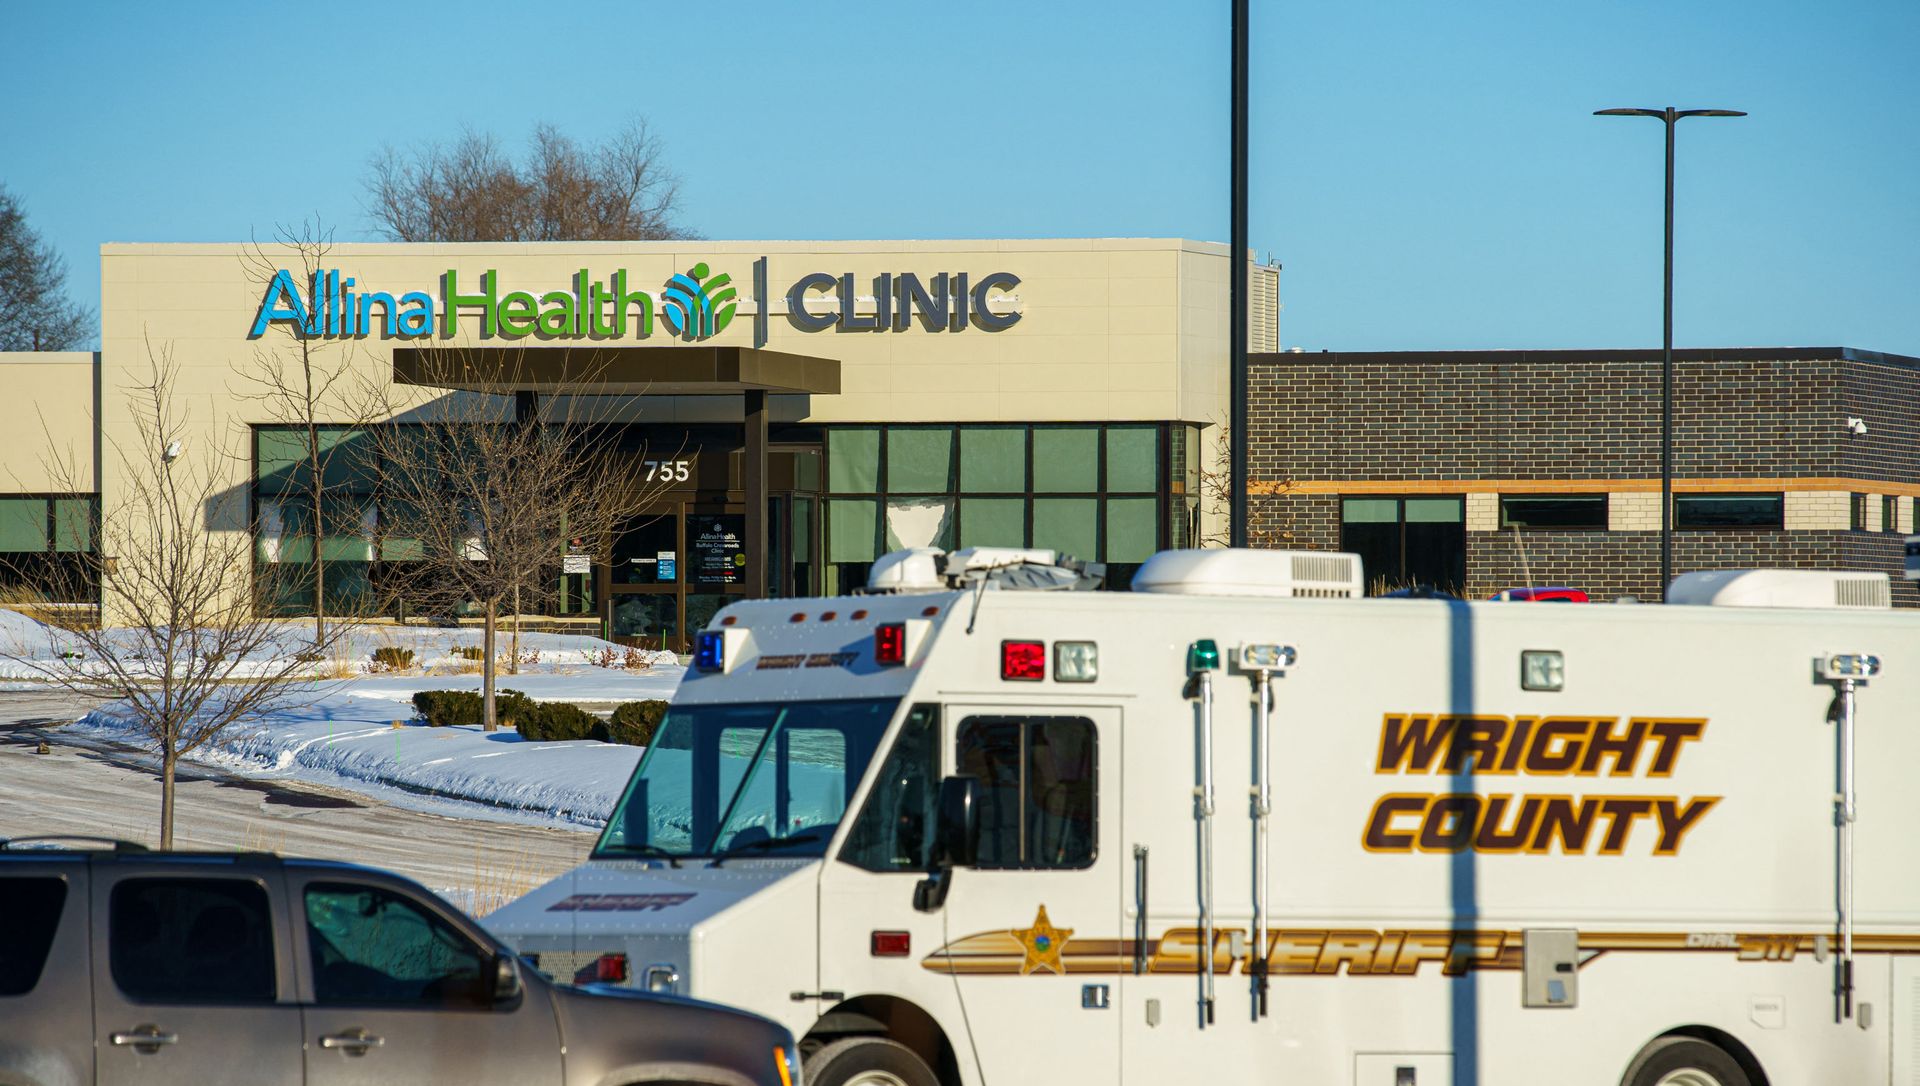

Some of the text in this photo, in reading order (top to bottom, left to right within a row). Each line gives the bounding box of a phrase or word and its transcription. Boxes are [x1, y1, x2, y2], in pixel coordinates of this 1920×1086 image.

[789, 271, 1023, 331] CLINIC
[644, 461, 689, 482] 755
[1374, 713, 1709, 778] WRIGHT
[1361, 792, 1725, 856] COUNTY
[1150, 928, 1506, 976] SHERIFF
